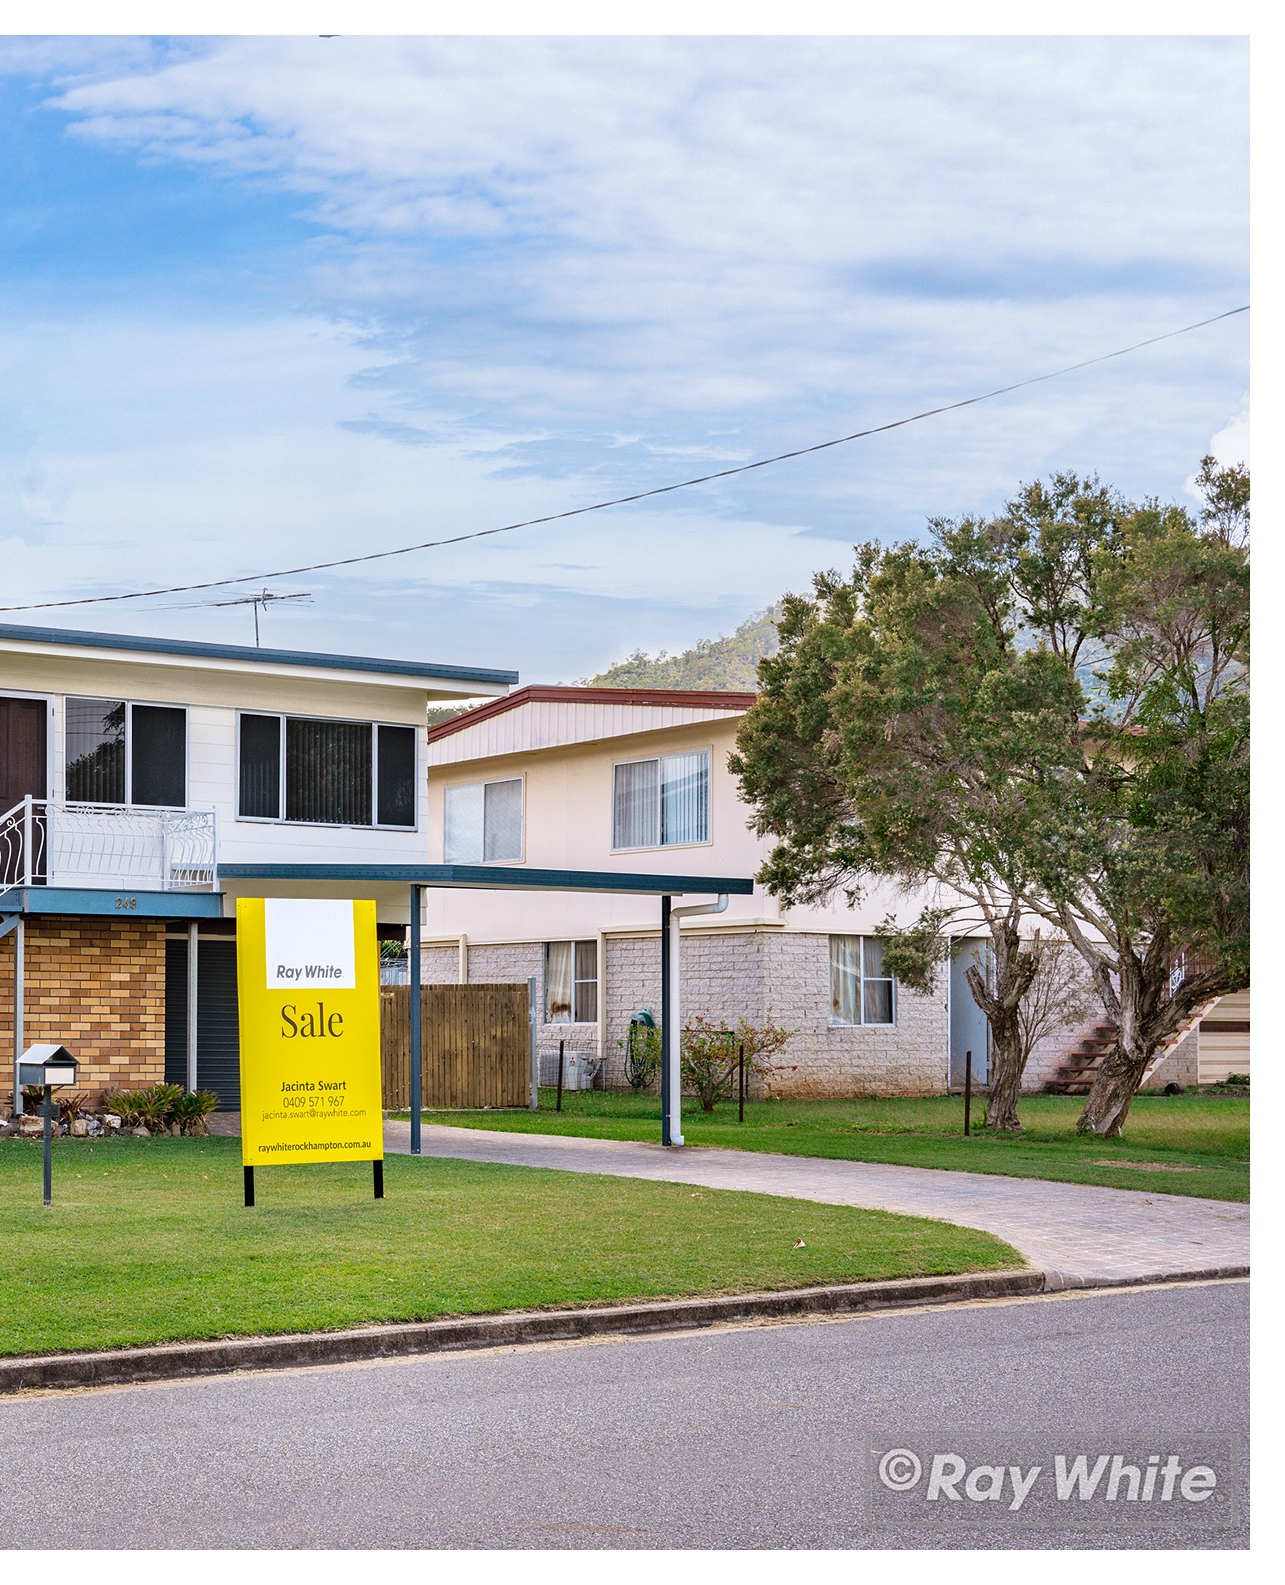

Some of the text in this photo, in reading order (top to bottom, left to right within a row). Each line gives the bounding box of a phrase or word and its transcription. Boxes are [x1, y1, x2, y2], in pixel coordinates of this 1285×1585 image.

[276, 964, 343, 981] Ray White
[281, 1002, 344, 1038] Sale
[280, 1080, 347, 1092] Jacinta Swart
[283, 1096, 345, 1108] 0409 571 967
[262, 1108, 366, 1121] jacinta.swart@raywhite.com
[258, 1141, 372, 1153] raywhiterockhampton.com.au
